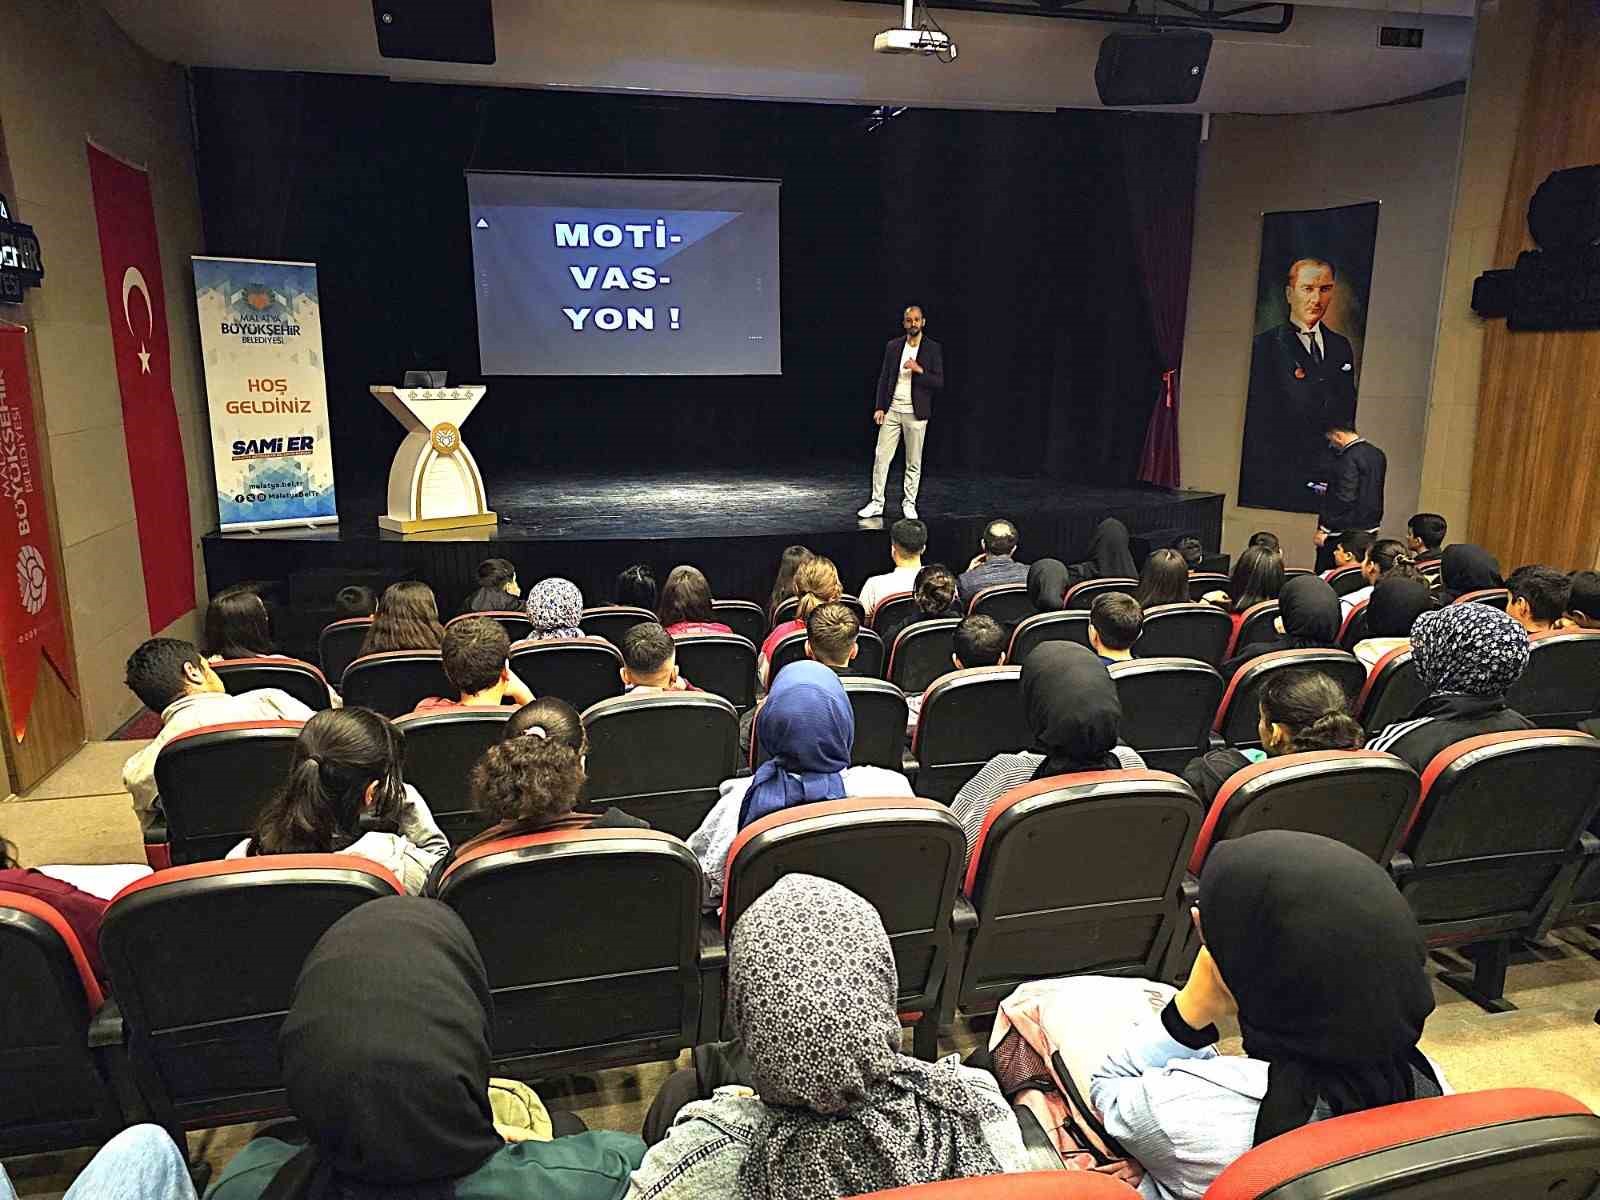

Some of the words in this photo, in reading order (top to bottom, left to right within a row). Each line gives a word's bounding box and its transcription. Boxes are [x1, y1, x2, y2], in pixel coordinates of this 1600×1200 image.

[554, 218, 682, 248] MOTİ-
[569, 266, 671, 290] VAS-
[562, 307, 654, 330] YON
[669, 307, 680, 329] !
[221, 322, 301, 336] BÜYÜKŞEHİR
[248, 378, 288, 396] HOŞ
[226, 397, 312, 414] GELDİNİZ
[287, 436, 314, 451] ER
